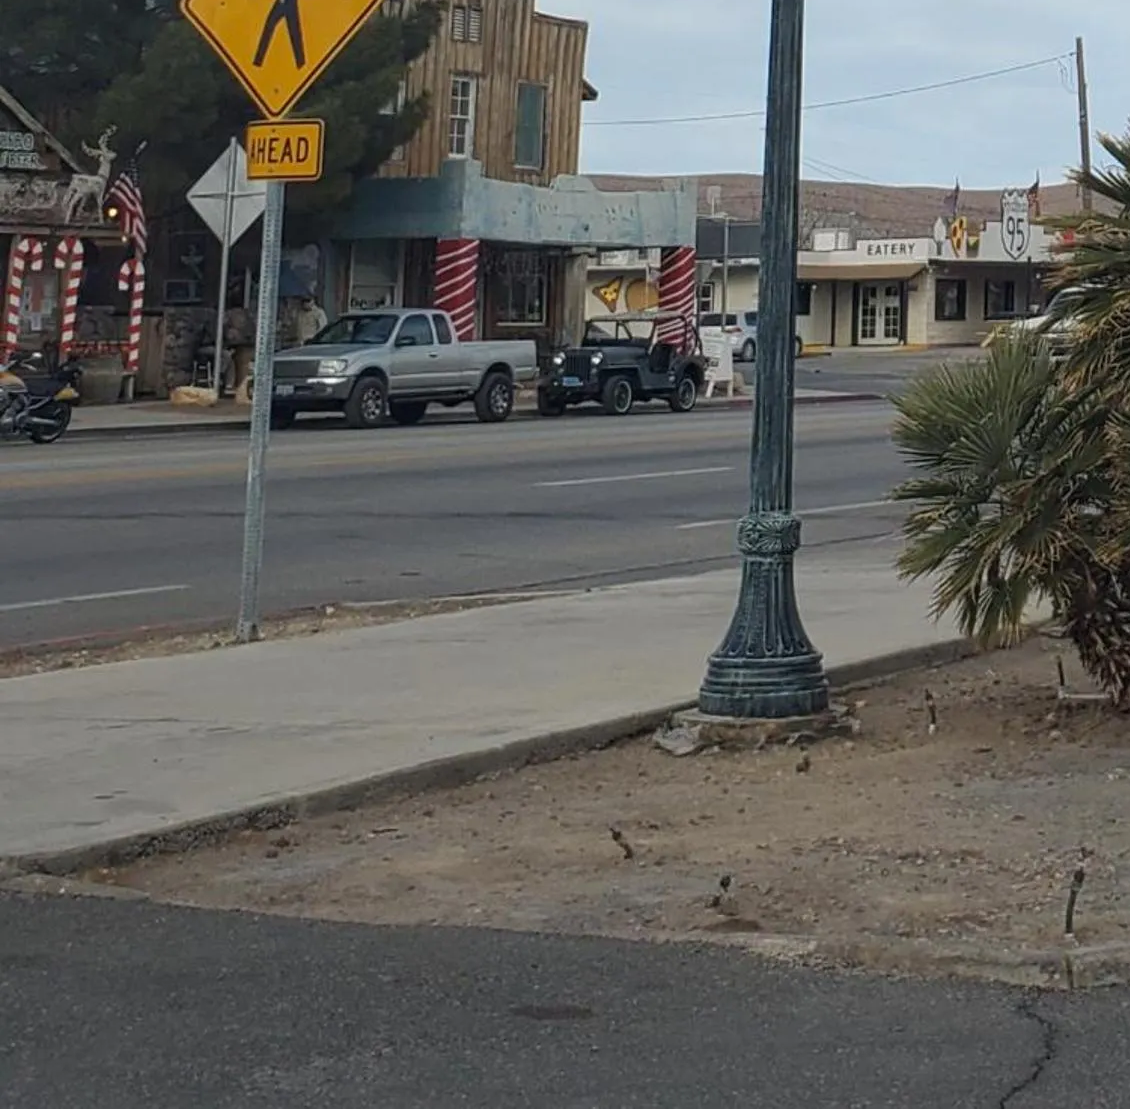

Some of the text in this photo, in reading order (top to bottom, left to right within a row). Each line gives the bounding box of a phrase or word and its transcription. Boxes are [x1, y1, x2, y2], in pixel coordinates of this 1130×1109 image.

[251, 137, 309, 164] AHEAD
[1006, 216, 1025, 252] 95
[866, 243, 917, 257] EATERY
